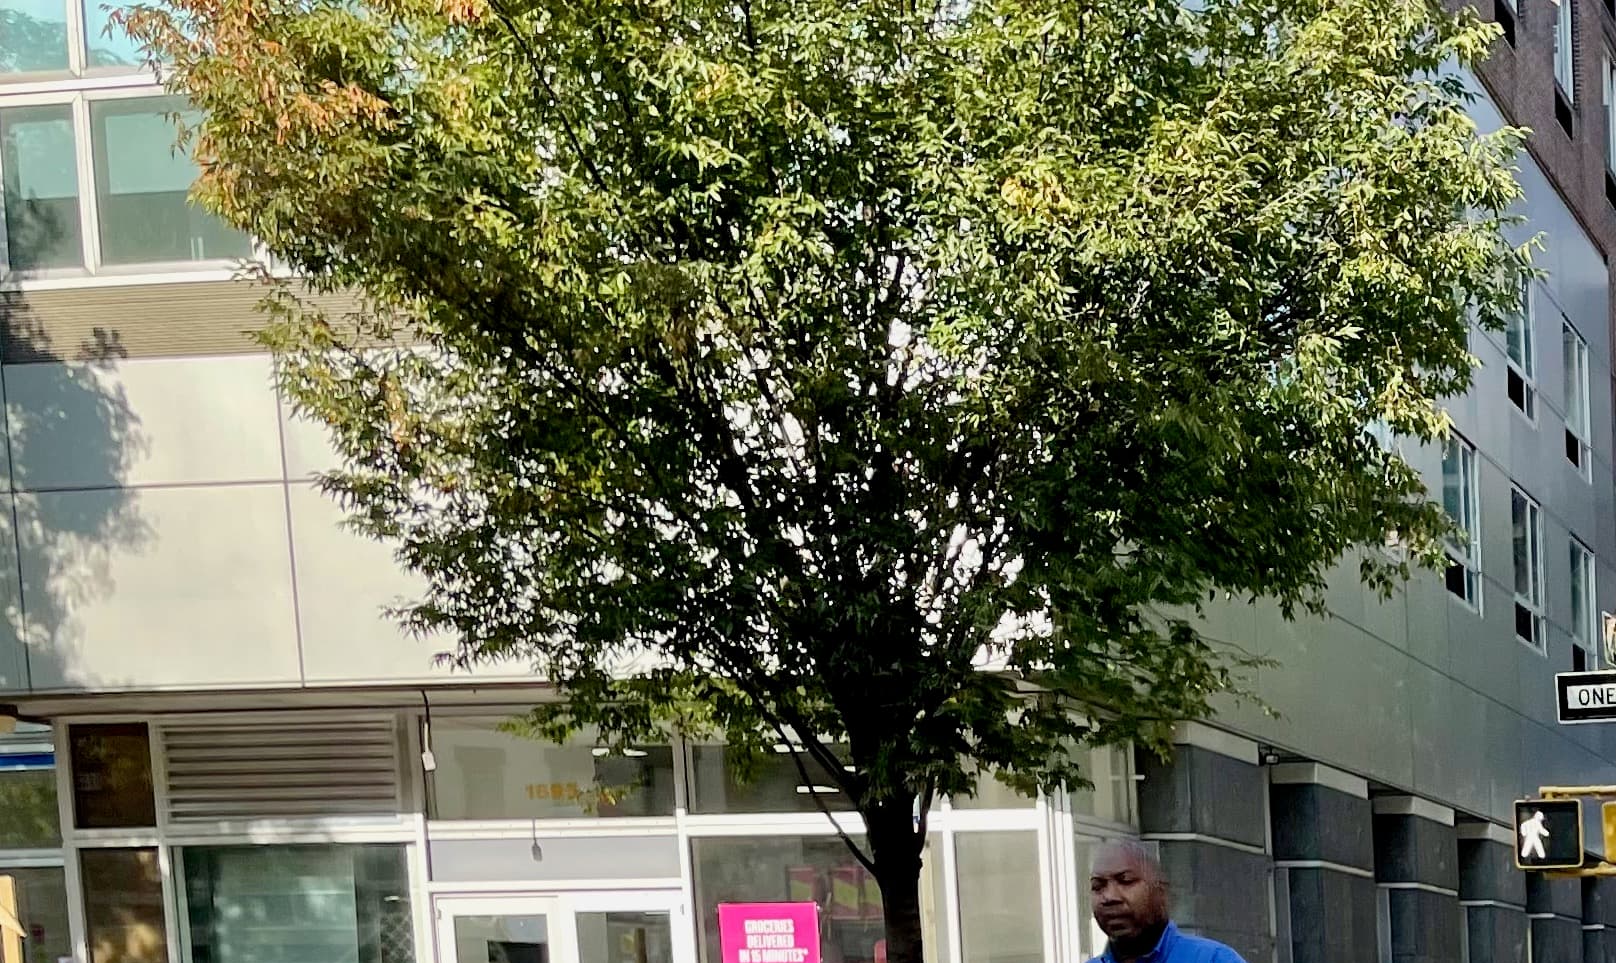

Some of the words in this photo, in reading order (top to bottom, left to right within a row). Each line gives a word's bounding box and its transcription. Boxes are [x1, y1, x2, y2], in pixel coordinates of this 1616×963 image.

[1578, 687, 1616, 706] ONE
[744, 919, 794, 934] GROCERIES
[746, 934, 795, 949] DELIVERED
[738, 949, 750, 963] IN
[751, 949, 761, 963] 15
